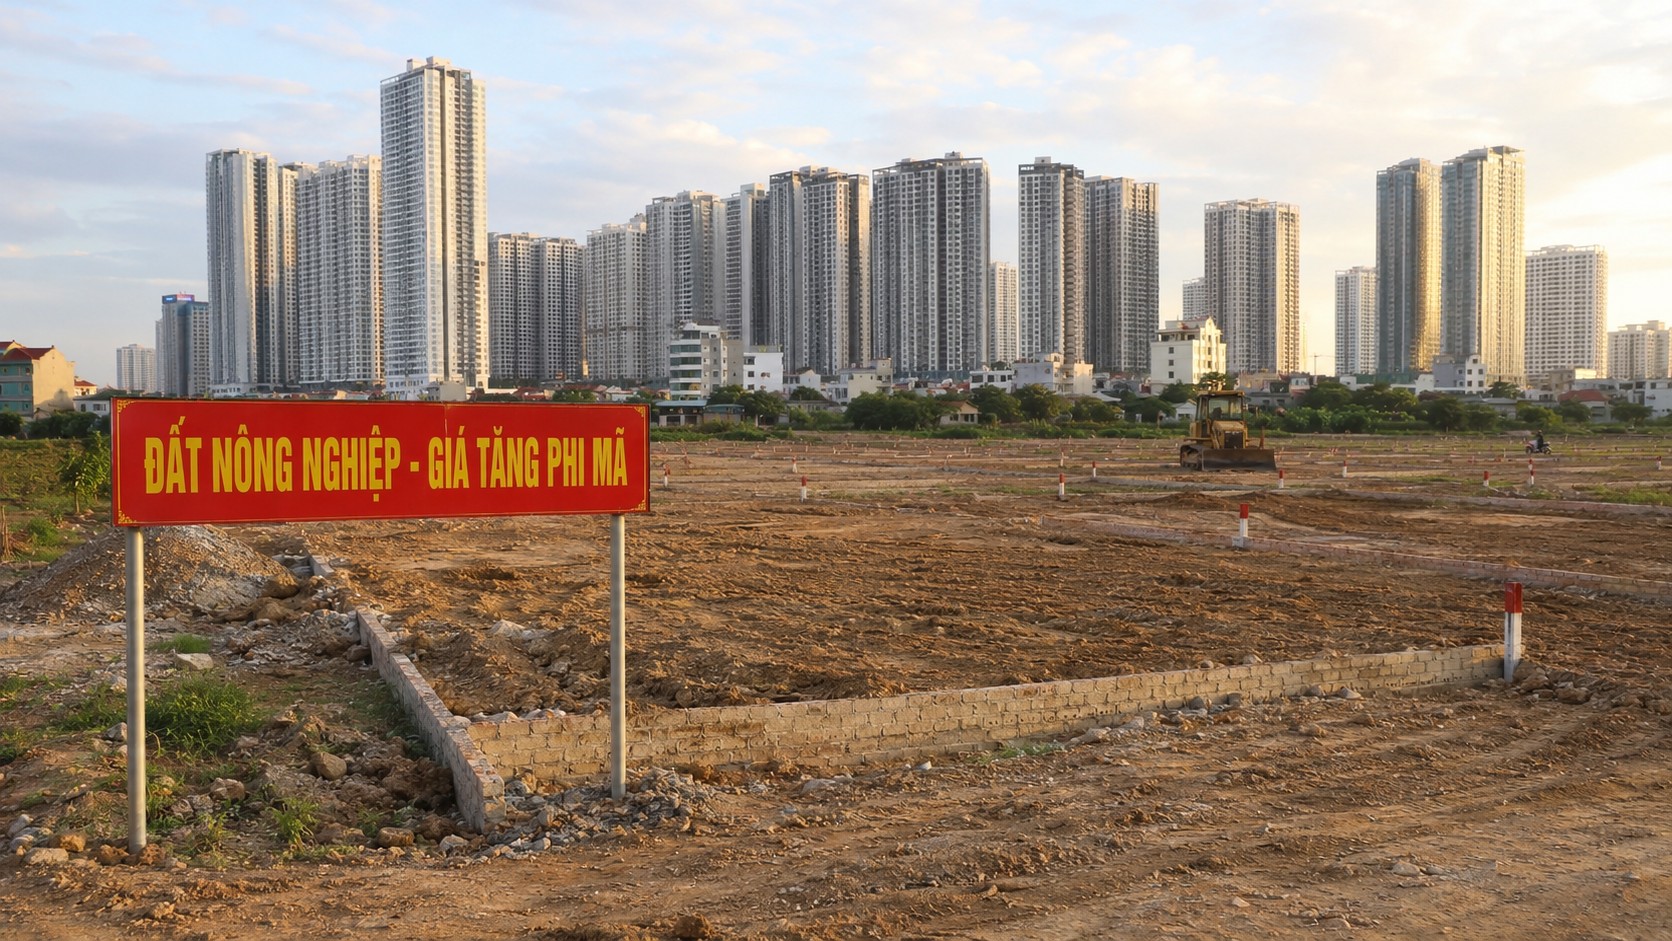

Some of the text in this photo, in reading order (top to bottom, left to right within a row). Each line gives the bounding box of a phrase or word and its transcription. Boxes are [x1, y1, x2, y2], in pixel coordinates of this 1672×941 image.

[144, 416, 628, 502] ĐẤT NÔNG NGHIỆP - GIÁ TĂNG PHI MÃ
